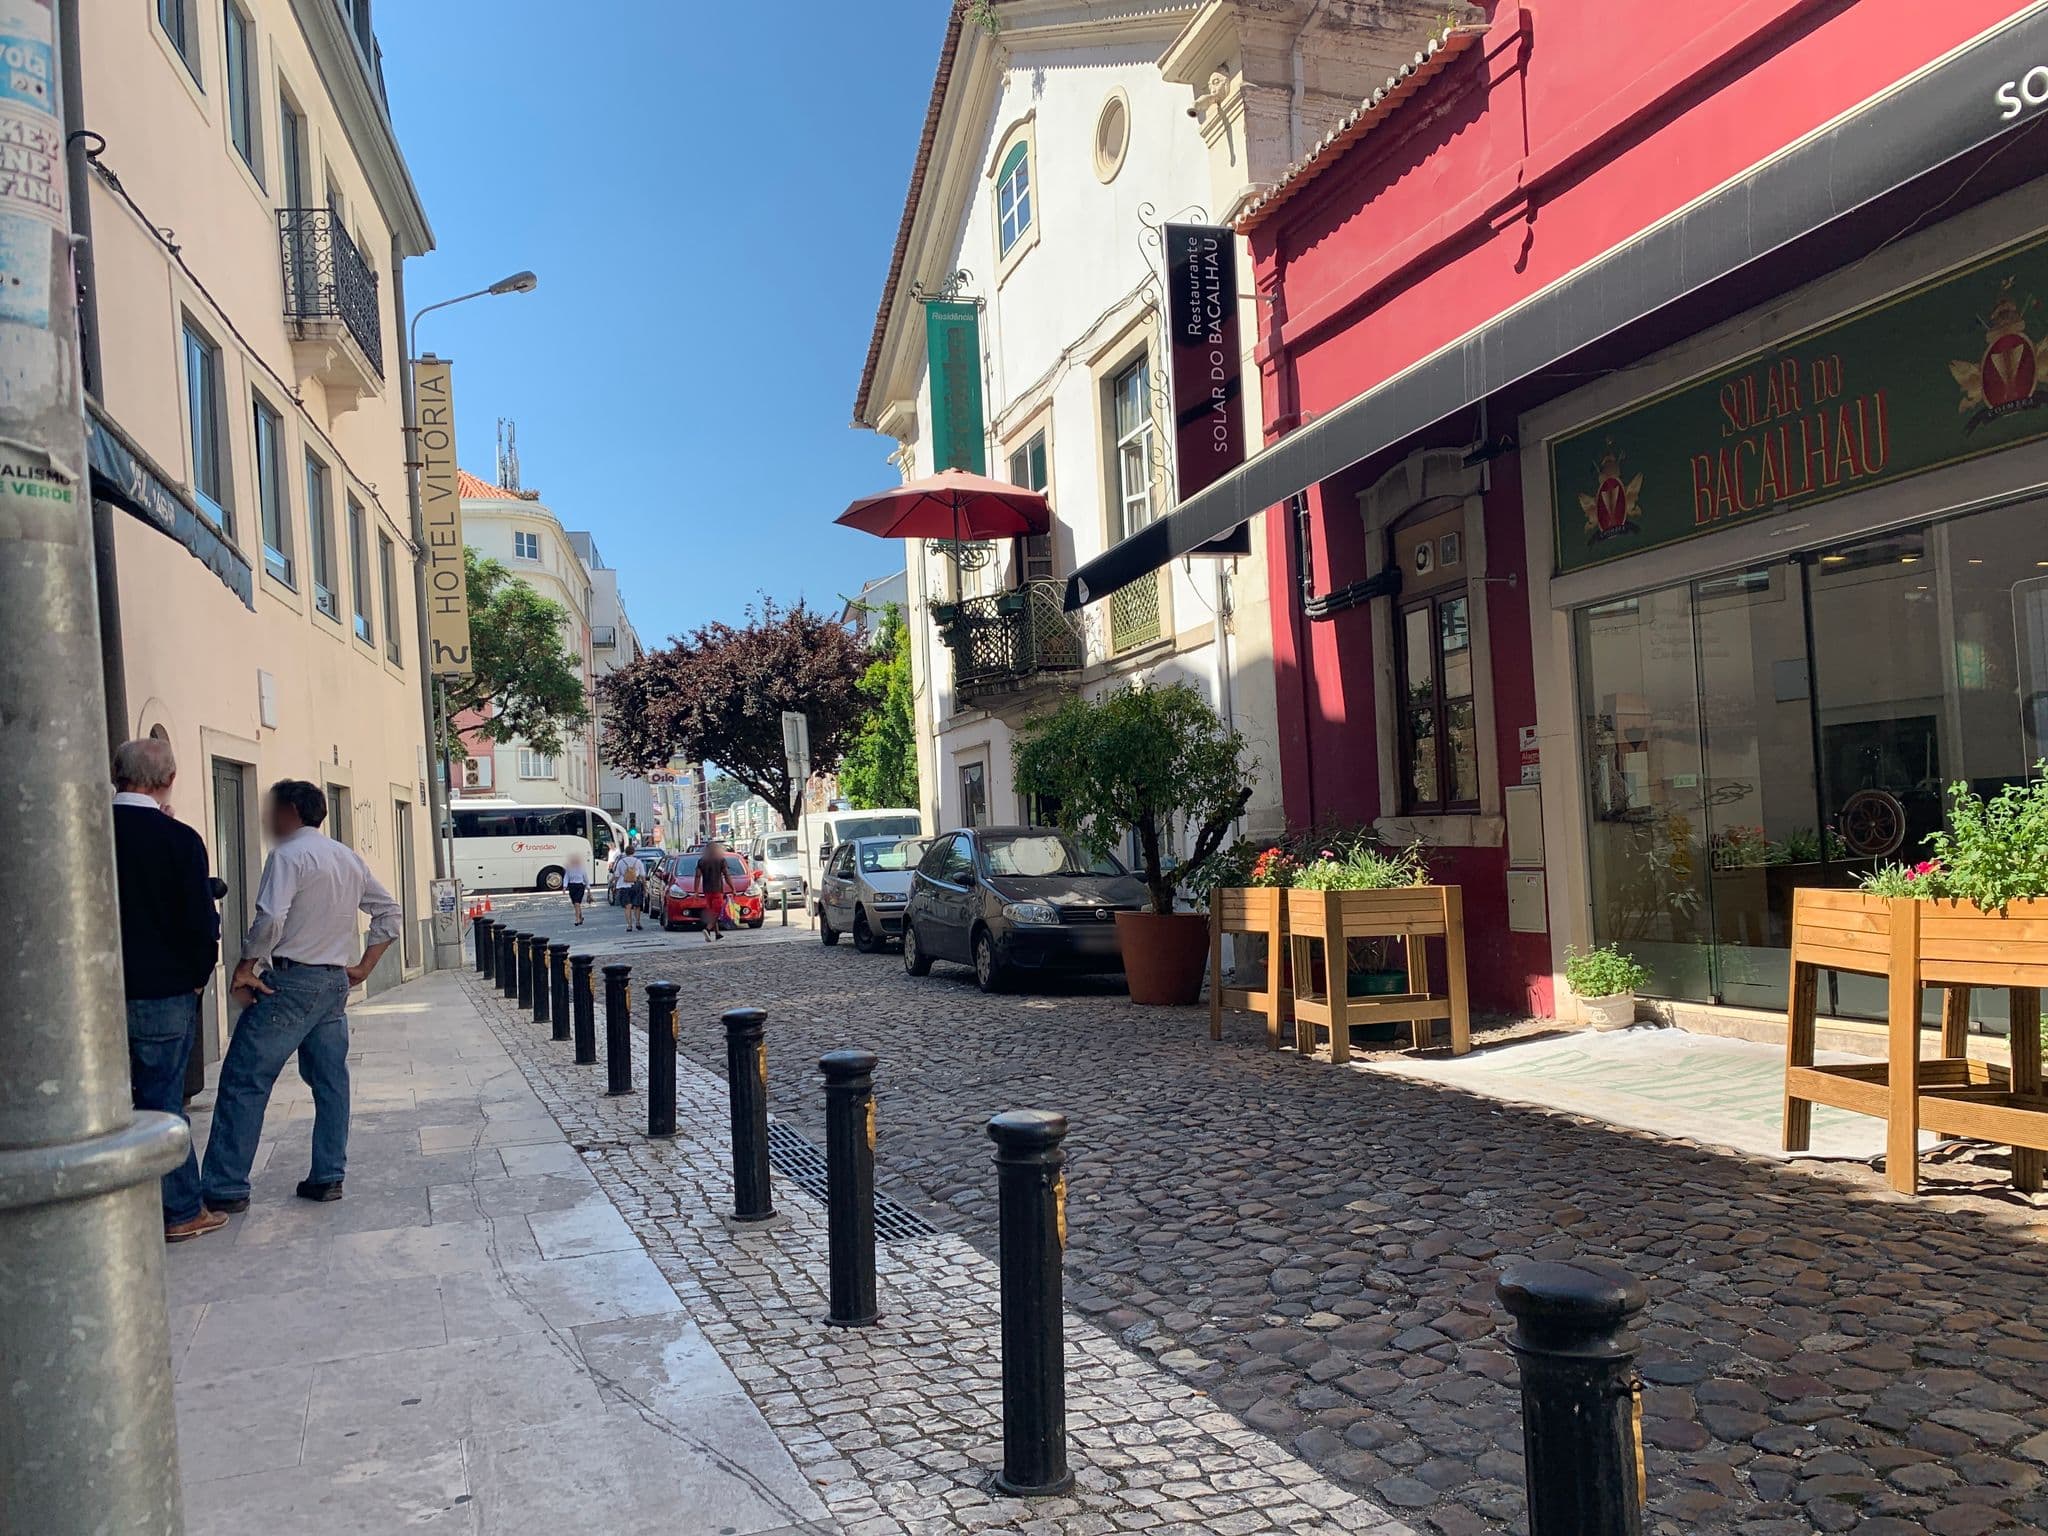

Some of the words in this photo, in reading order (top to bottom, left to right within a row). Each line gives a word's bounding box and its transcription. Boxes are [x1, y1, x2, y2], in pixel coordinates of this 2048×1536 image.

[1996, 65, 2048, 119] SO
[0, 142, 51, 184] NE
[1187, 236, 1202, 335] Restaurante
[1203, 238, 1223, 344] BACALHAU
[1210, 350, 1225, 380] DO
[1212, 388, 1228, 452] SOLAR
[1720, 358, 1802, 438] SOLAR
[1812, 354, 1844, 405] DO
[418, 375, 453, 503] VITÓRIA
[1689, 388, 1889, 527] BACALHAU
[0, 463, 71, 486] ALISMO
[12, 481, 72, 504] VERDE
[430, 511, 461, 614] HOTEL
[652, 773, 675, 783] Oslo
[525, 843, 557, 851] transdev
